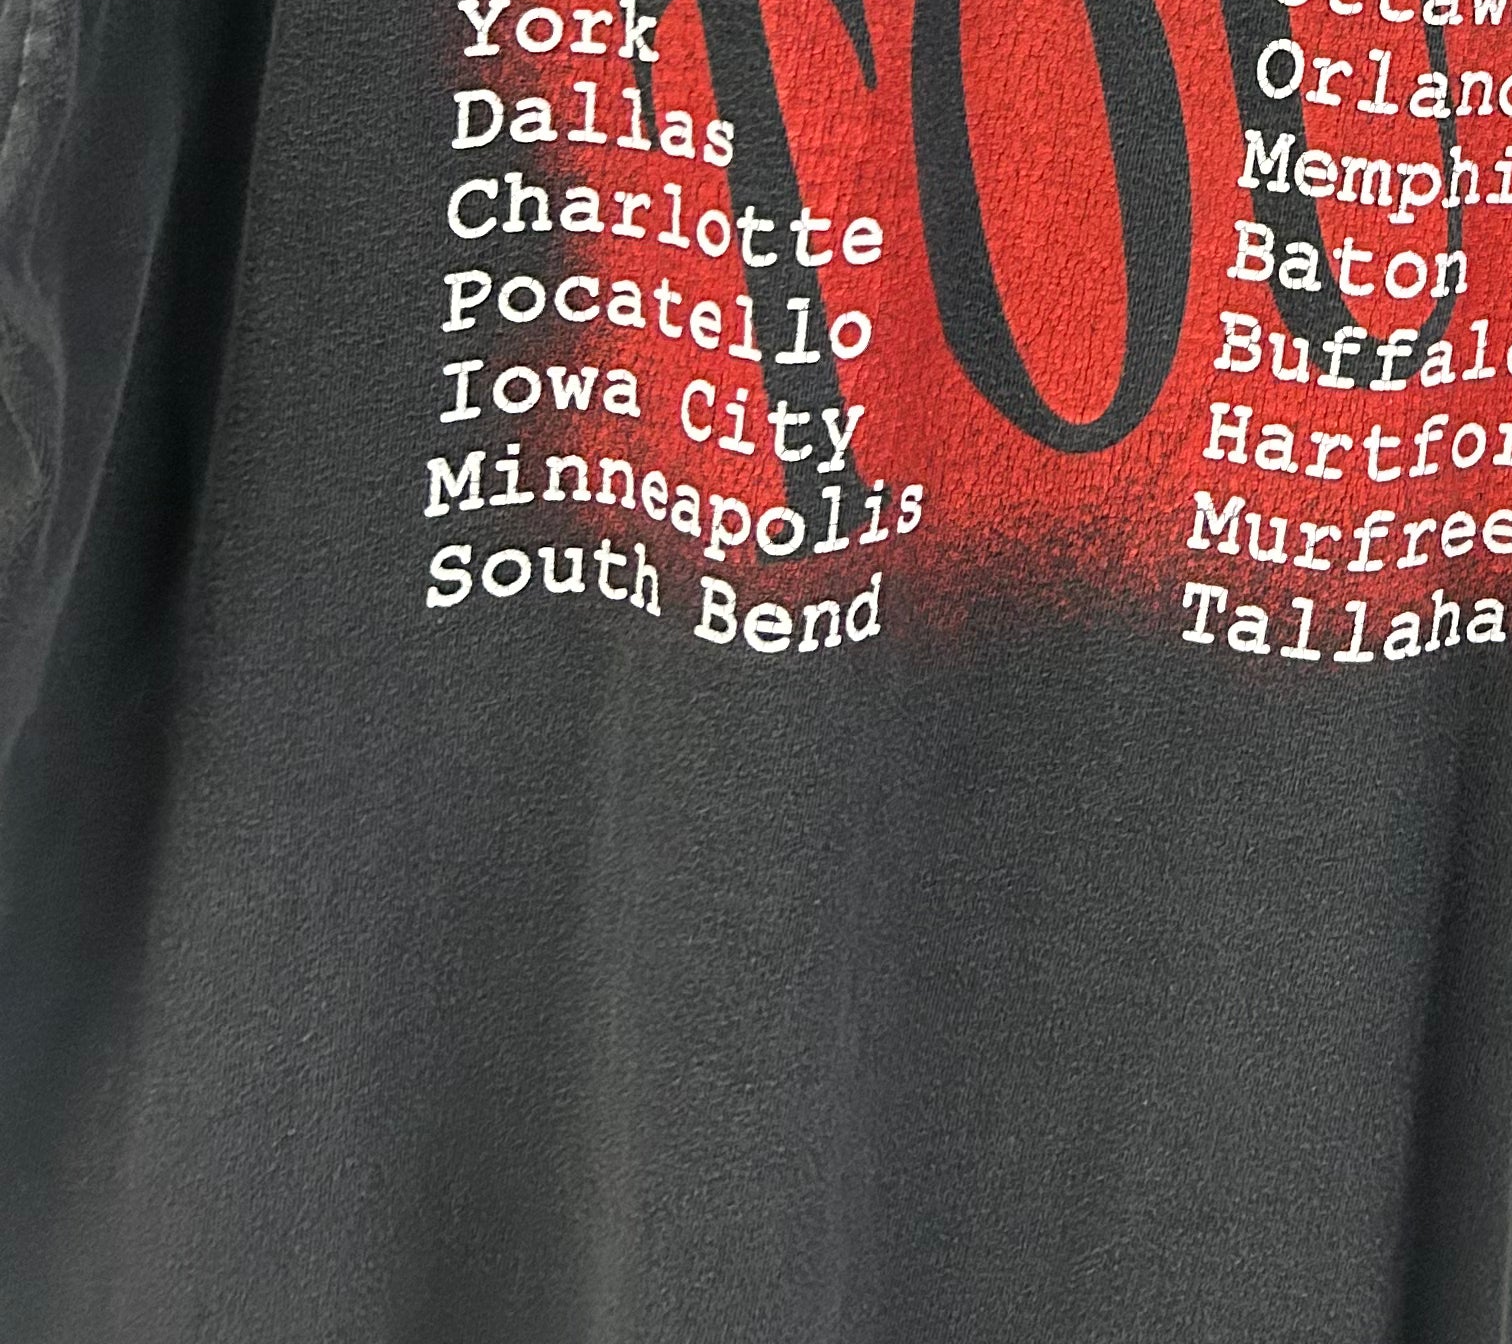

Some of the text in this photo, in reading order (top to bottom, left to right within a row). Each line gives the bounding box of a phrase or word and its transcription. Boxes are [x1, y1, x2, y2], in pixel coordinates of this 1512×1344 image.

[452, 81, 734, 166] Dallas
[448, 172, 883, 267] Charlotte
[1227, 220, 1467, 298] Baton
[441, 270, 872, 364] Pocatello
[440, 360, 865, 473] Iowa City
[424, 444, 923, 561] Minneapolis
[426, 539, 882, 653] South Bend
